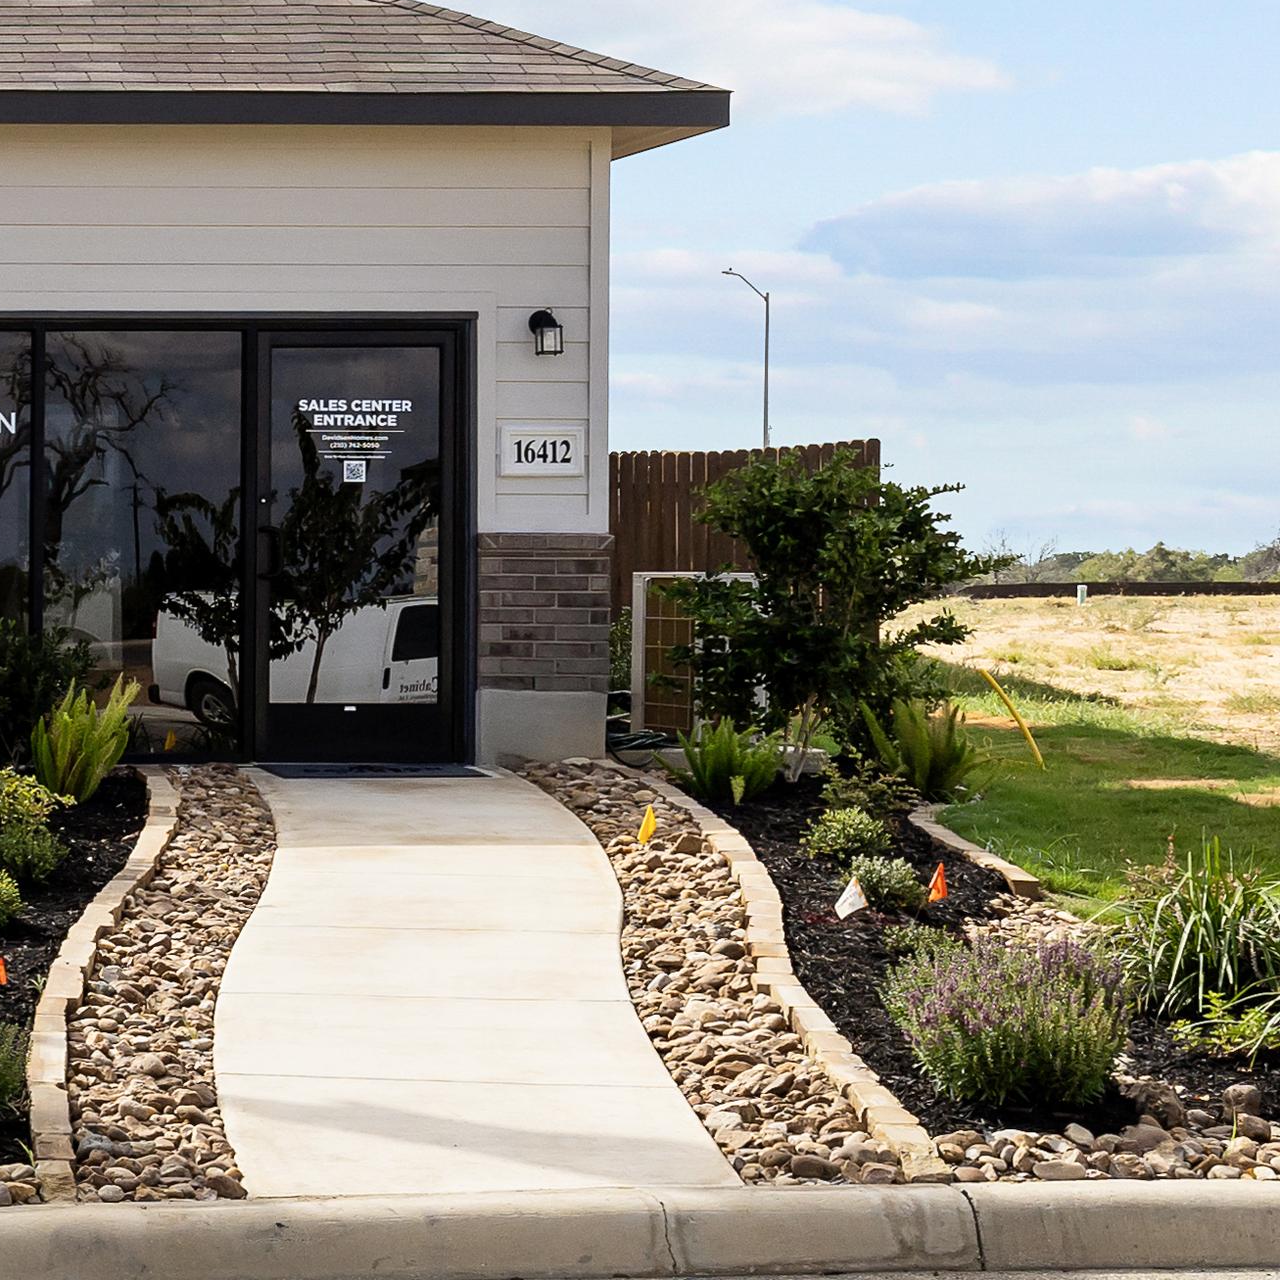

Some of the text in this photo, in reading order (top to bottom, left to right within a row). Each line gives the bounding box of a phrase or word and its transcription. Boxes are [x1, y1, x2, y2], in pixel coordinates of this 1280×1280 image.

[298, 399, 412, 412] SALES CENTER
[313, 414, 398, 427] ENTRANCE
[513, 439, 572, 464] 16412
